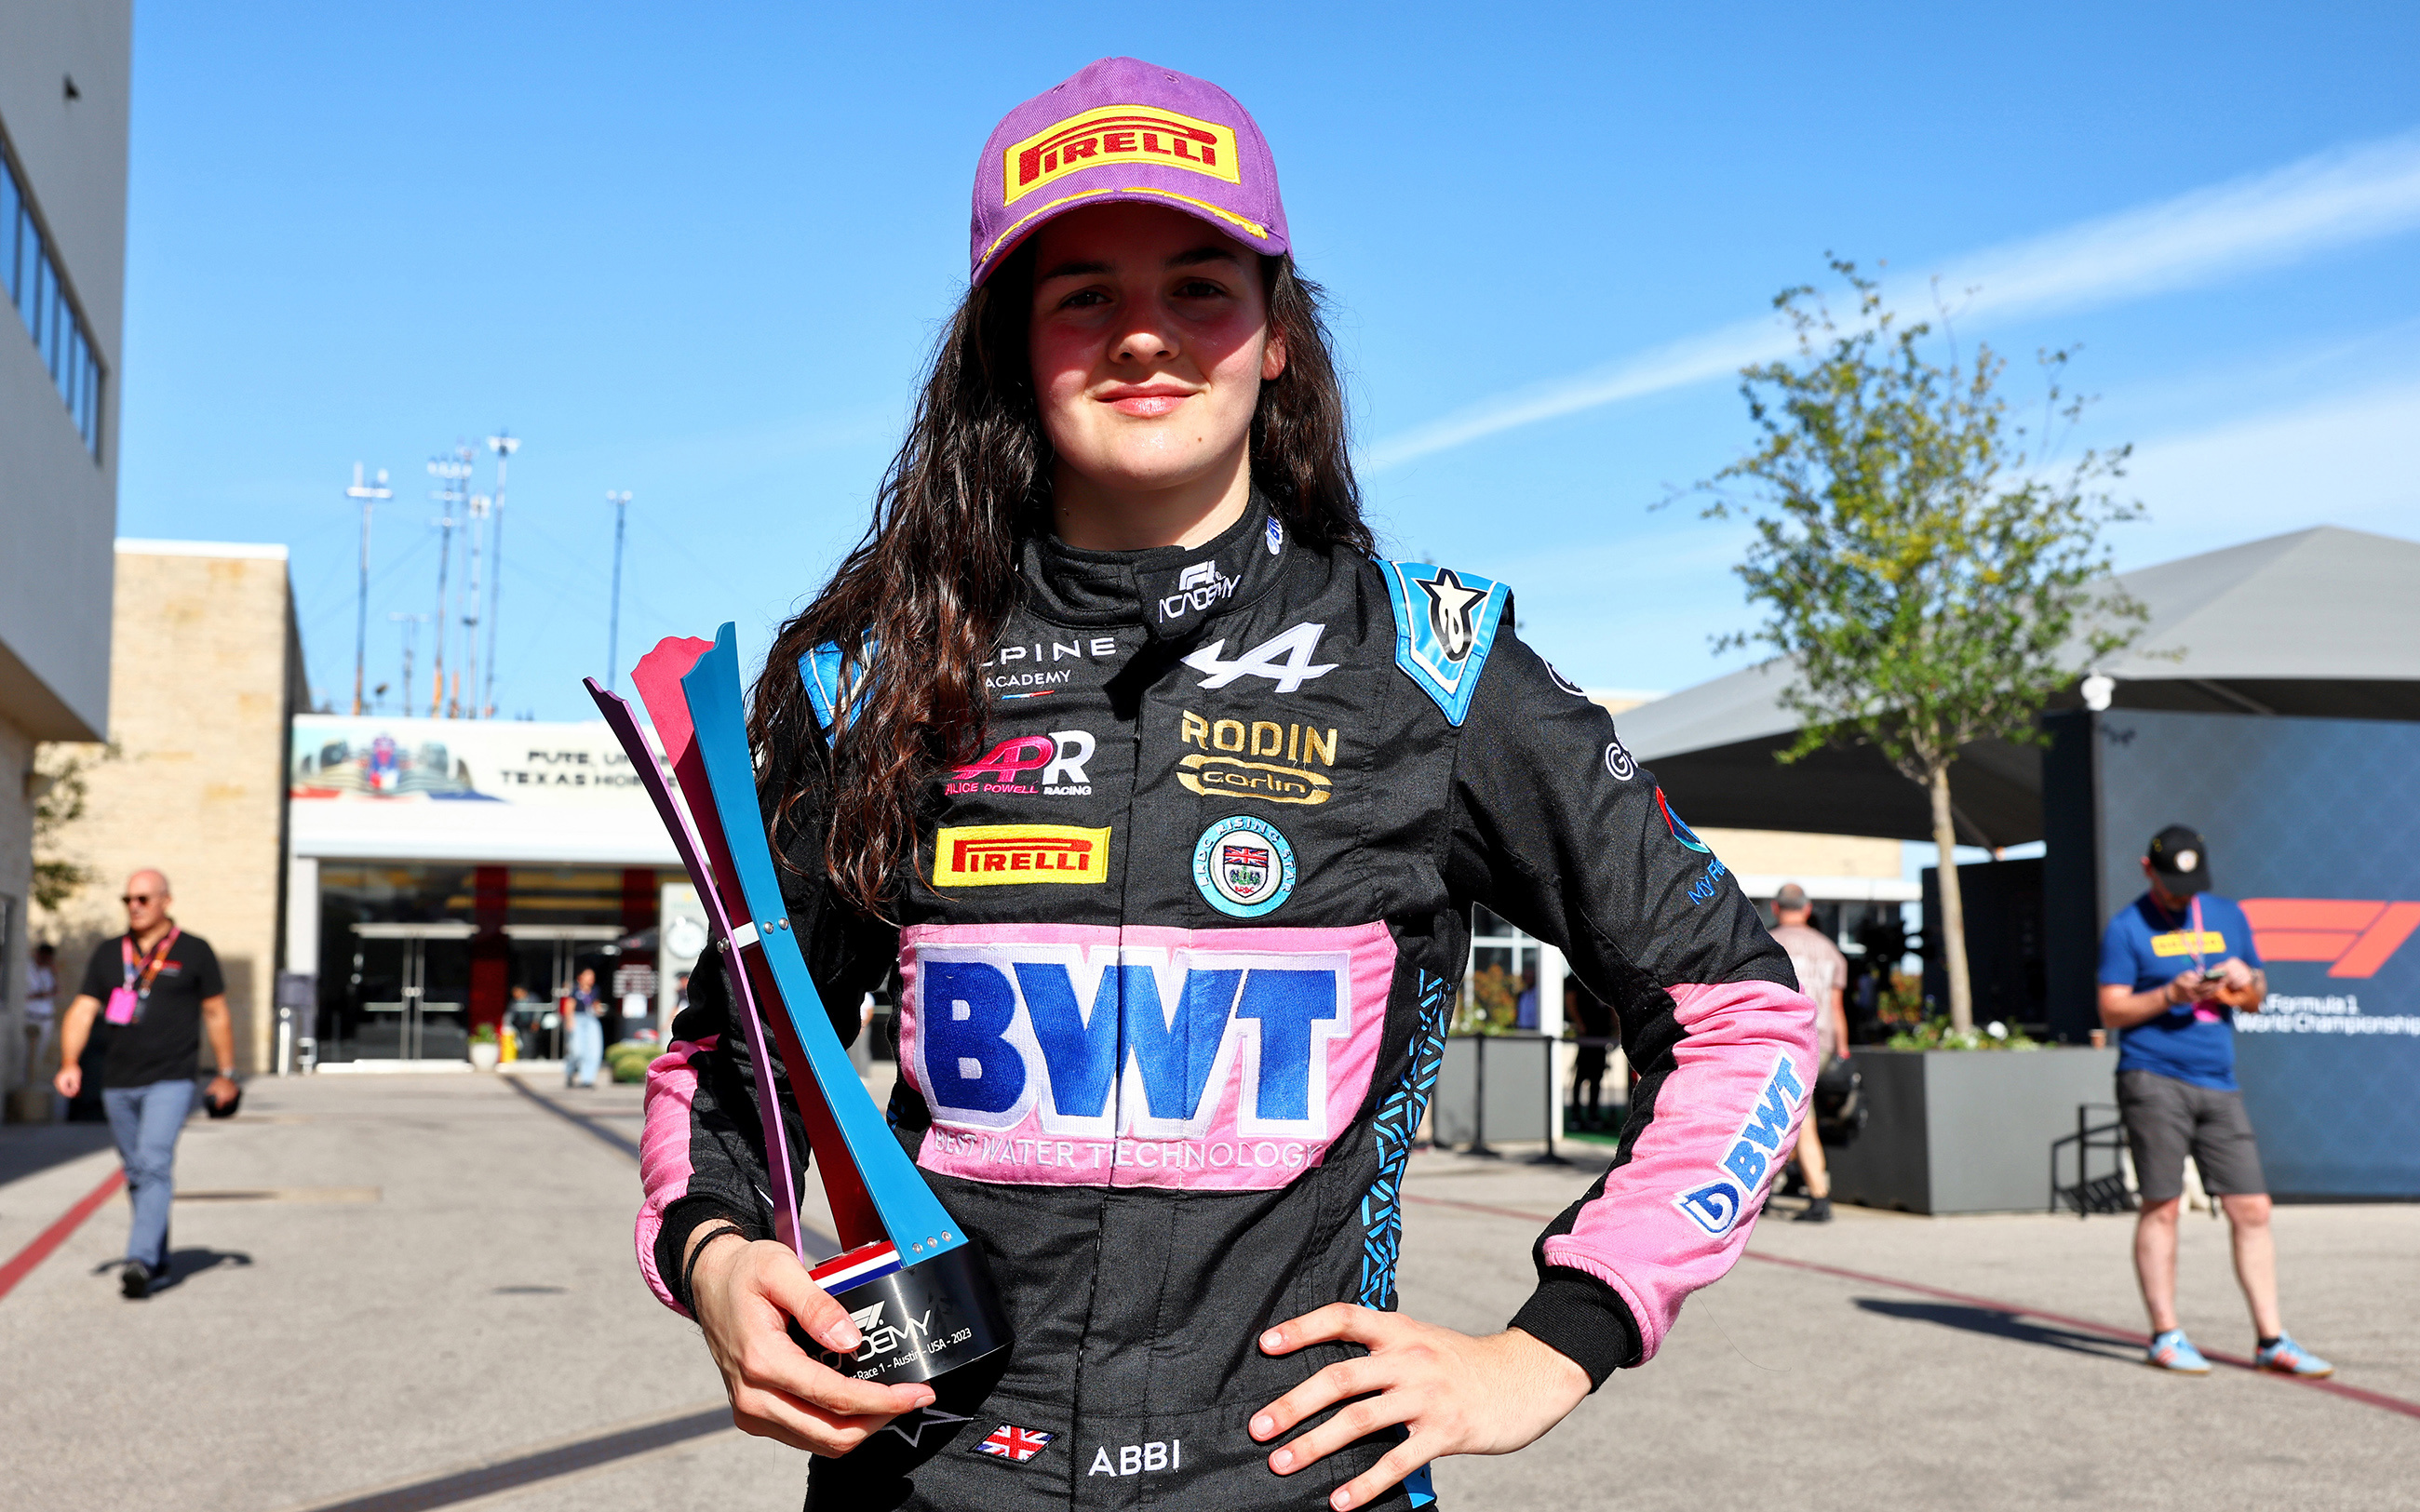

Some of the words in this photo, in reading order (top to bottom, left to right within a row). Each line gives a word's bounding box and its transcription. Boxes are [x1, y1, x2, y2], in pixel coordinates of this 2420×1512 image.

[1019, 115, 1217, 186] PIRELLI
[1159, 574, 1242, 623] ACADEMY
[981, 637, 1117, 667] PINE
[985, 669, 1071, 689] ACADEMY
[1181, 709, 1338, 767] RODIN
[500, 770, 586, 785] TEXAS
[944, 782, 979, 796] ALICE
[983, 782, 1039, 795] POWELL
[1043, 785, 1092, 796] RACING
[1203, 769, 1306, 793] carlin
[951, 837, 1094, 873] PIRELLI
[1215, 818, 1280, 843] RISING
[1281, 849, 1296, 893] STAR
[922, 959, 1338, 1122] BWT
[1724, 1056, 1804, 1194] BWT
[934, 1127, 977, 1157] BEST
[980, 1136, 1076, 1169] WATER
[1086, 1141, 1324, 1169] TECHNOLOGY
[856, 1368, 879, 1380] Race
[893, 1350, 920, 1369] Austin
[927, 1338, 947, 1354] USA
[950, 1328, 972, 1345] 2023
[1087, 1438, 1180, 1478] ABBI
